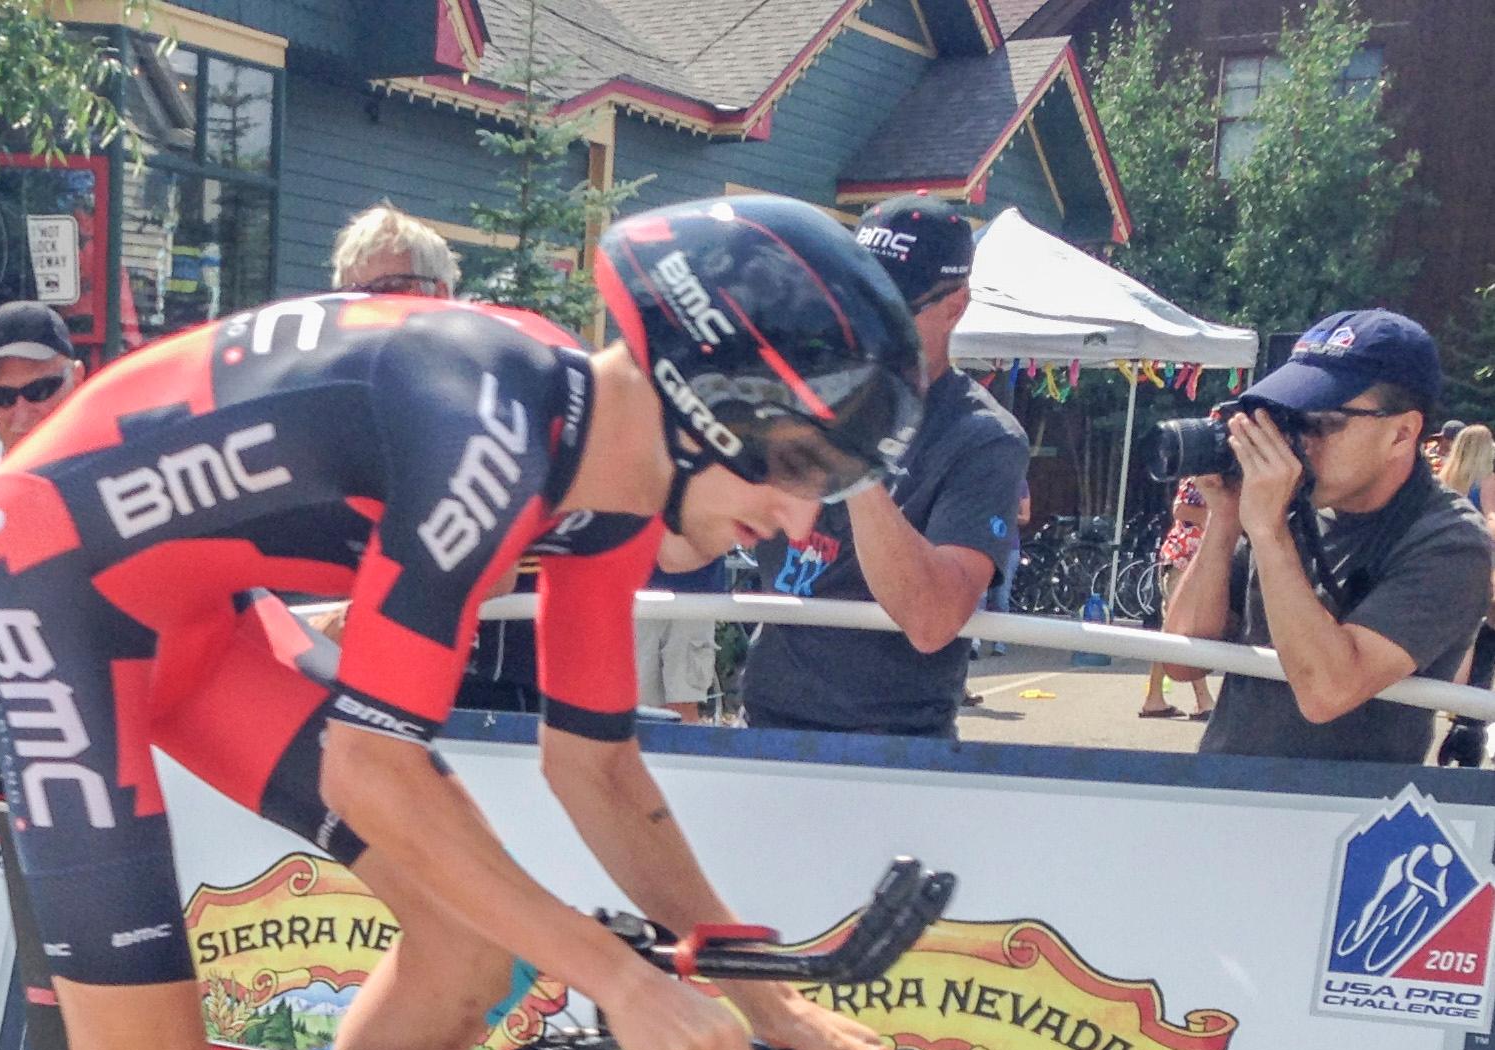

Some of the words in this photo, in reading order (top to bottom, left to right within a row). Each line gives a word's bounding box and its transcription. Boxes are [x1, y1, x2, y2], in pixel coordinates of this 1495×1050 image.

[32, 240, 56, 253] LOCK
[857, 226, 917, 253] BMC
[656, 250, 735, 345] BMC
[655, 357, 743, 458] GIRO
[97, 423, 292, 540] BMC
[417, 372, 528, 572] BMC
[335, 694, 424, 737] BMC
[196, 915, 339, 964] SIERRA
[1425, 949, 1478, 975] 2015
[799, 975, 927, 1016] ERRA
[1322, 995, 1481, 1020] CHALLENGE
[1324, 980, 1396, 1000] USA
[1405, 987, 1483, 1007] PRO
